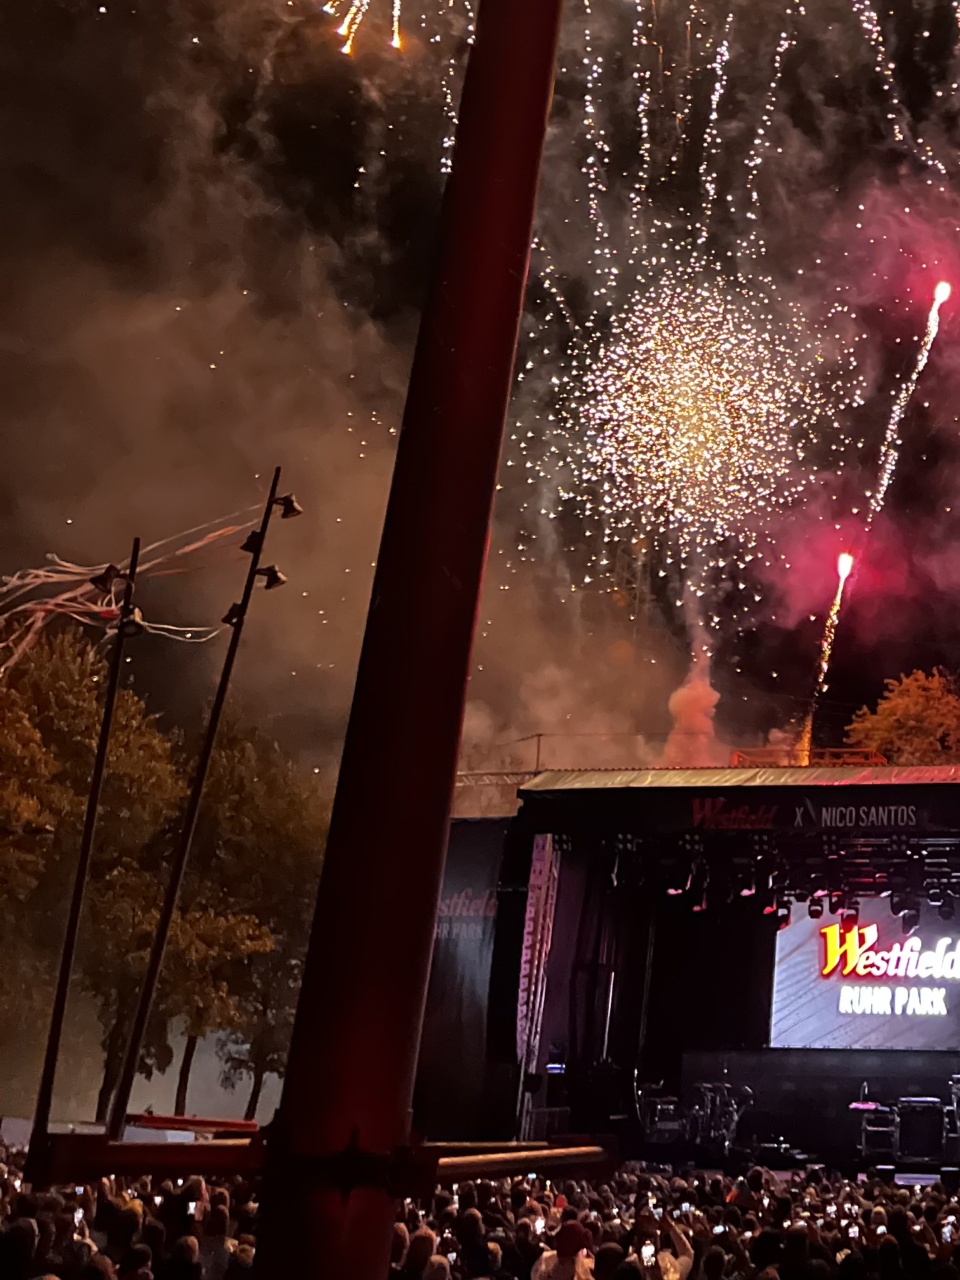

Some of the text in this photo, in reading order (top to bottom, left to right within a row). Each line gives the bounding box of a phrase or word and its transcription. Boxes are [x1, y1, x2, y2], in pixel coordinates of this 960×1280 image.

[691, 796, 779, 830] Westfield
[821, 806, 856, 828] NICO
[859, 805, 917, 827] SANTOS
[838, 985, 948, 1016] RUHR PARK
